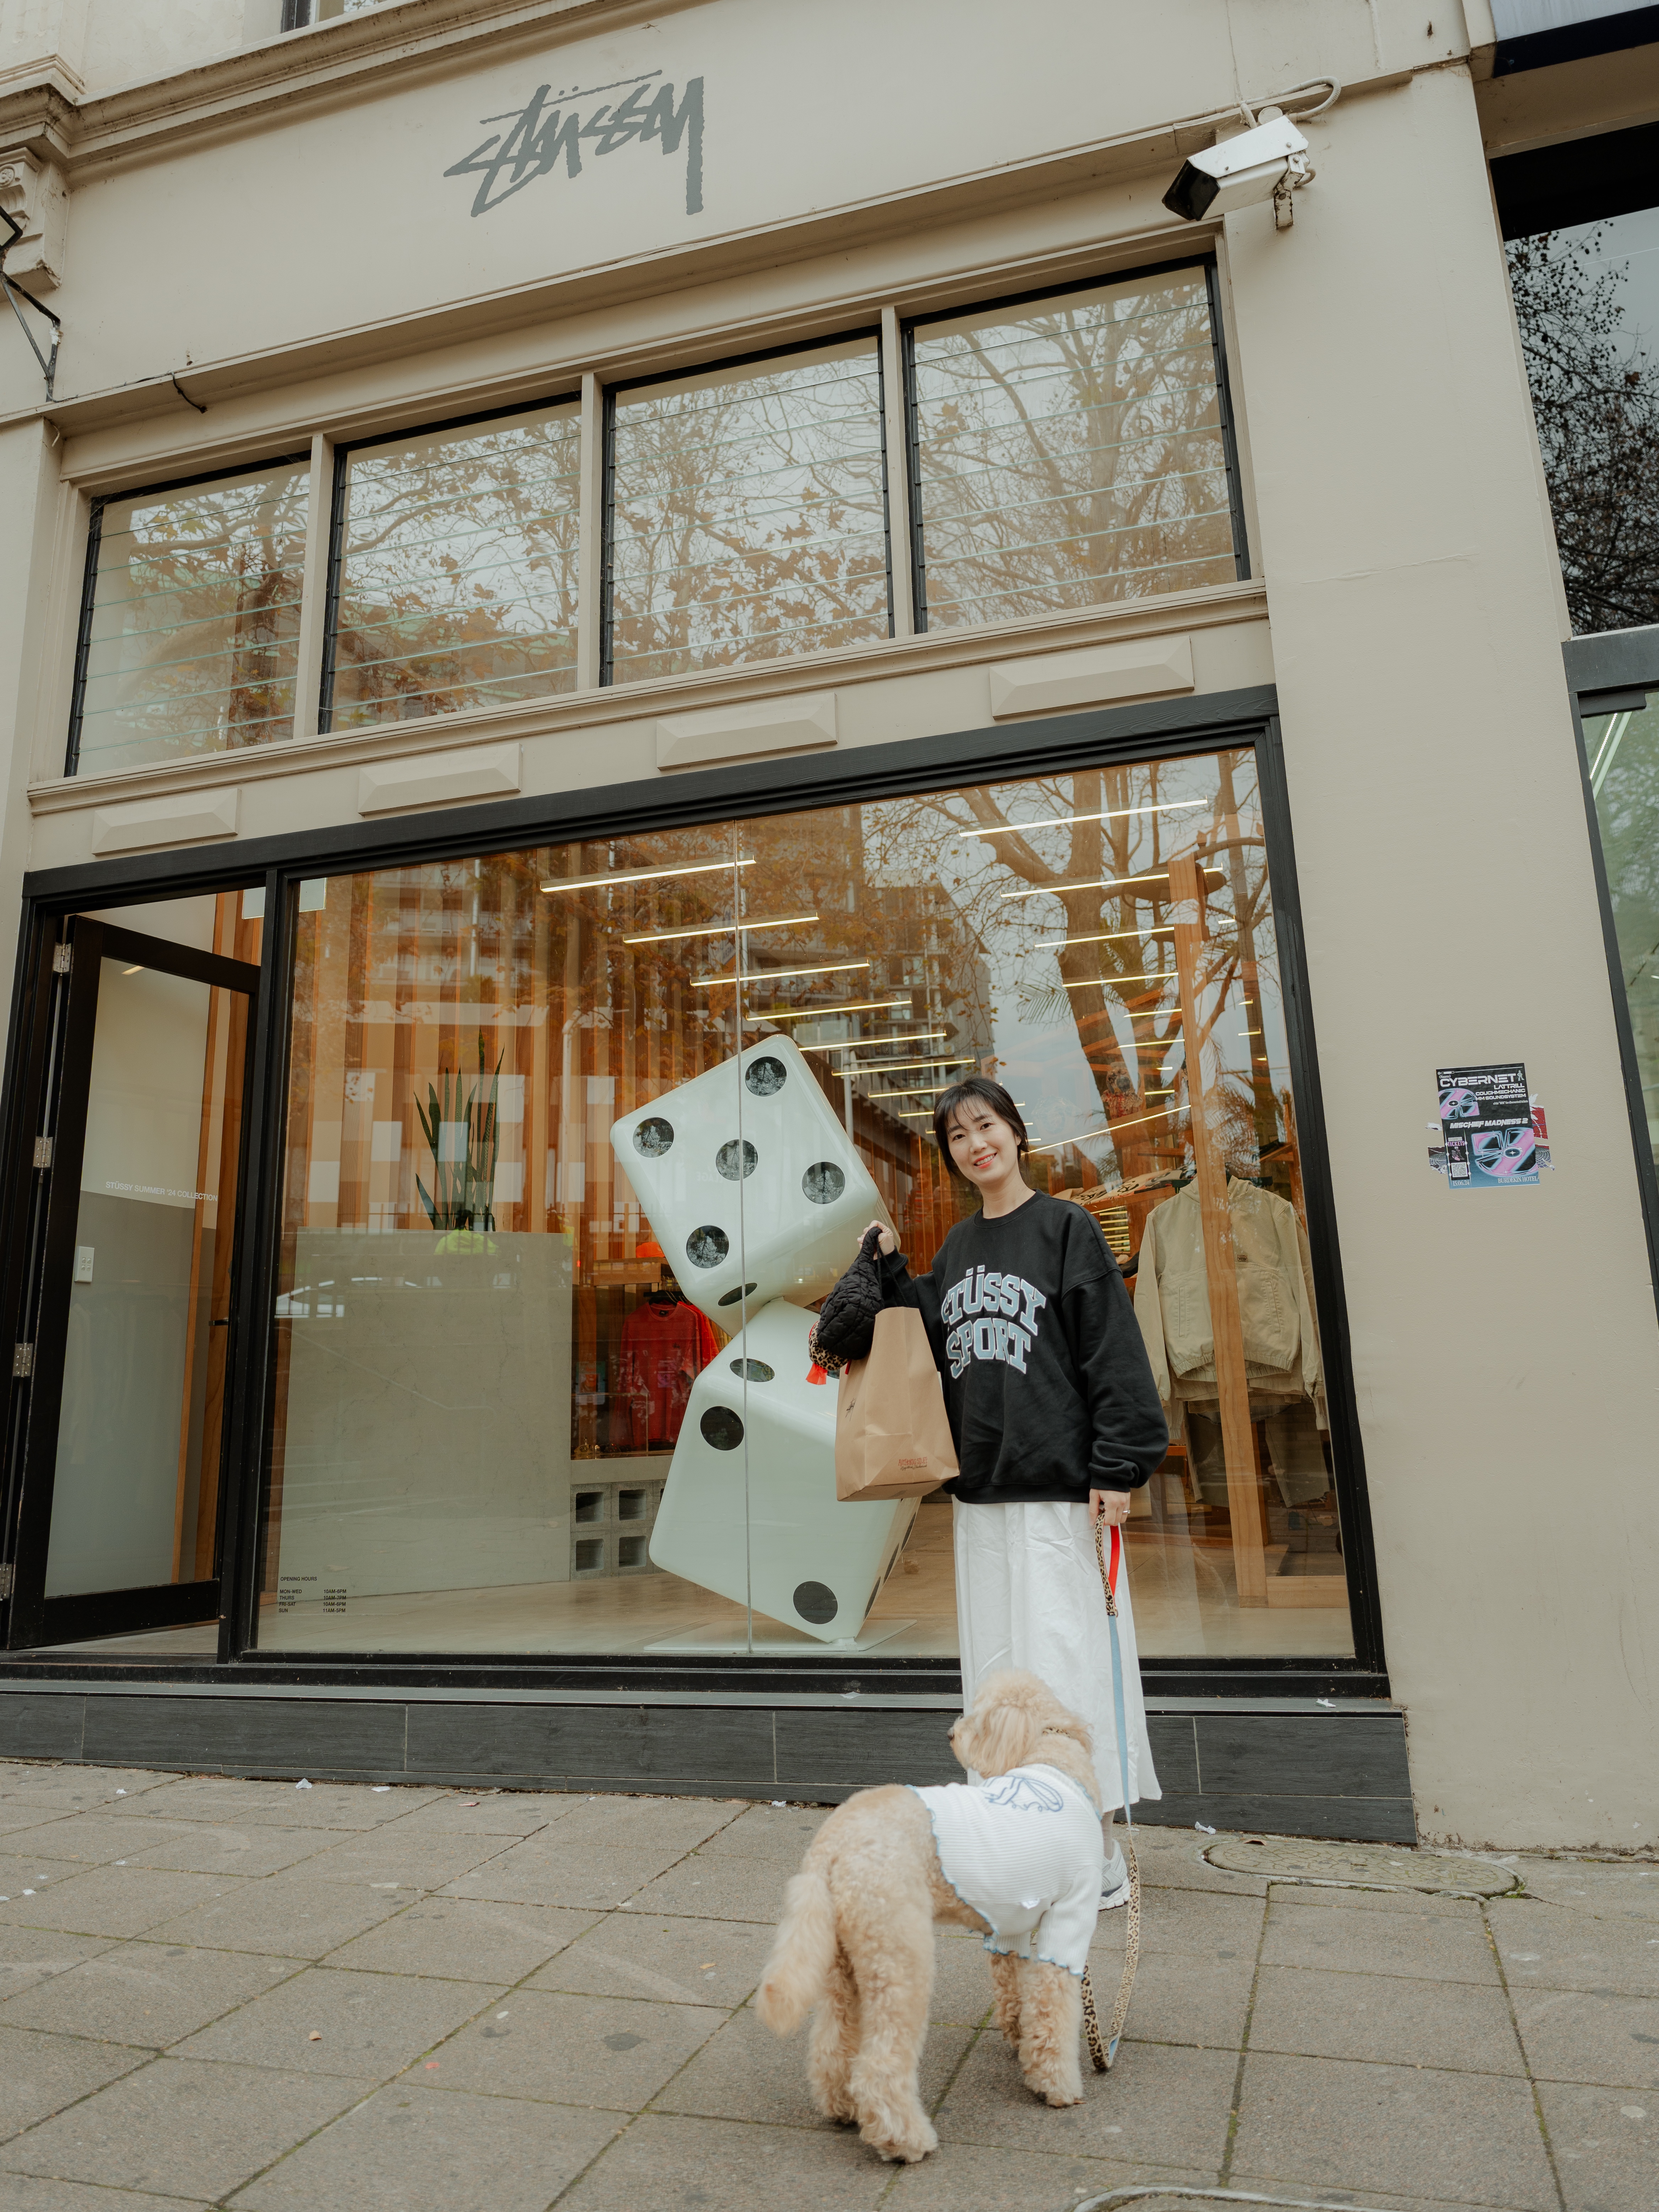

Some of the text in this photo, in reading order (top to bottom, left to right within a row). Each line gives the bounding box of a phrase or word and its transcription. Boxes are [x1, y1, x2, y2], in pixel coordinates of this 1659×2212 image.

[1440, 1073, 1516, 1087] CYBERNET
[1450, 1121, 1484, 1129] MISCHIEF
[106, 1181, 133, 1191] STÜSSY
[134, 1185, 165, 1195] SUMMER
[178, 1190, 218, 1202] COLLECTION
[946, 1317, 1031, 1379] SPORT
